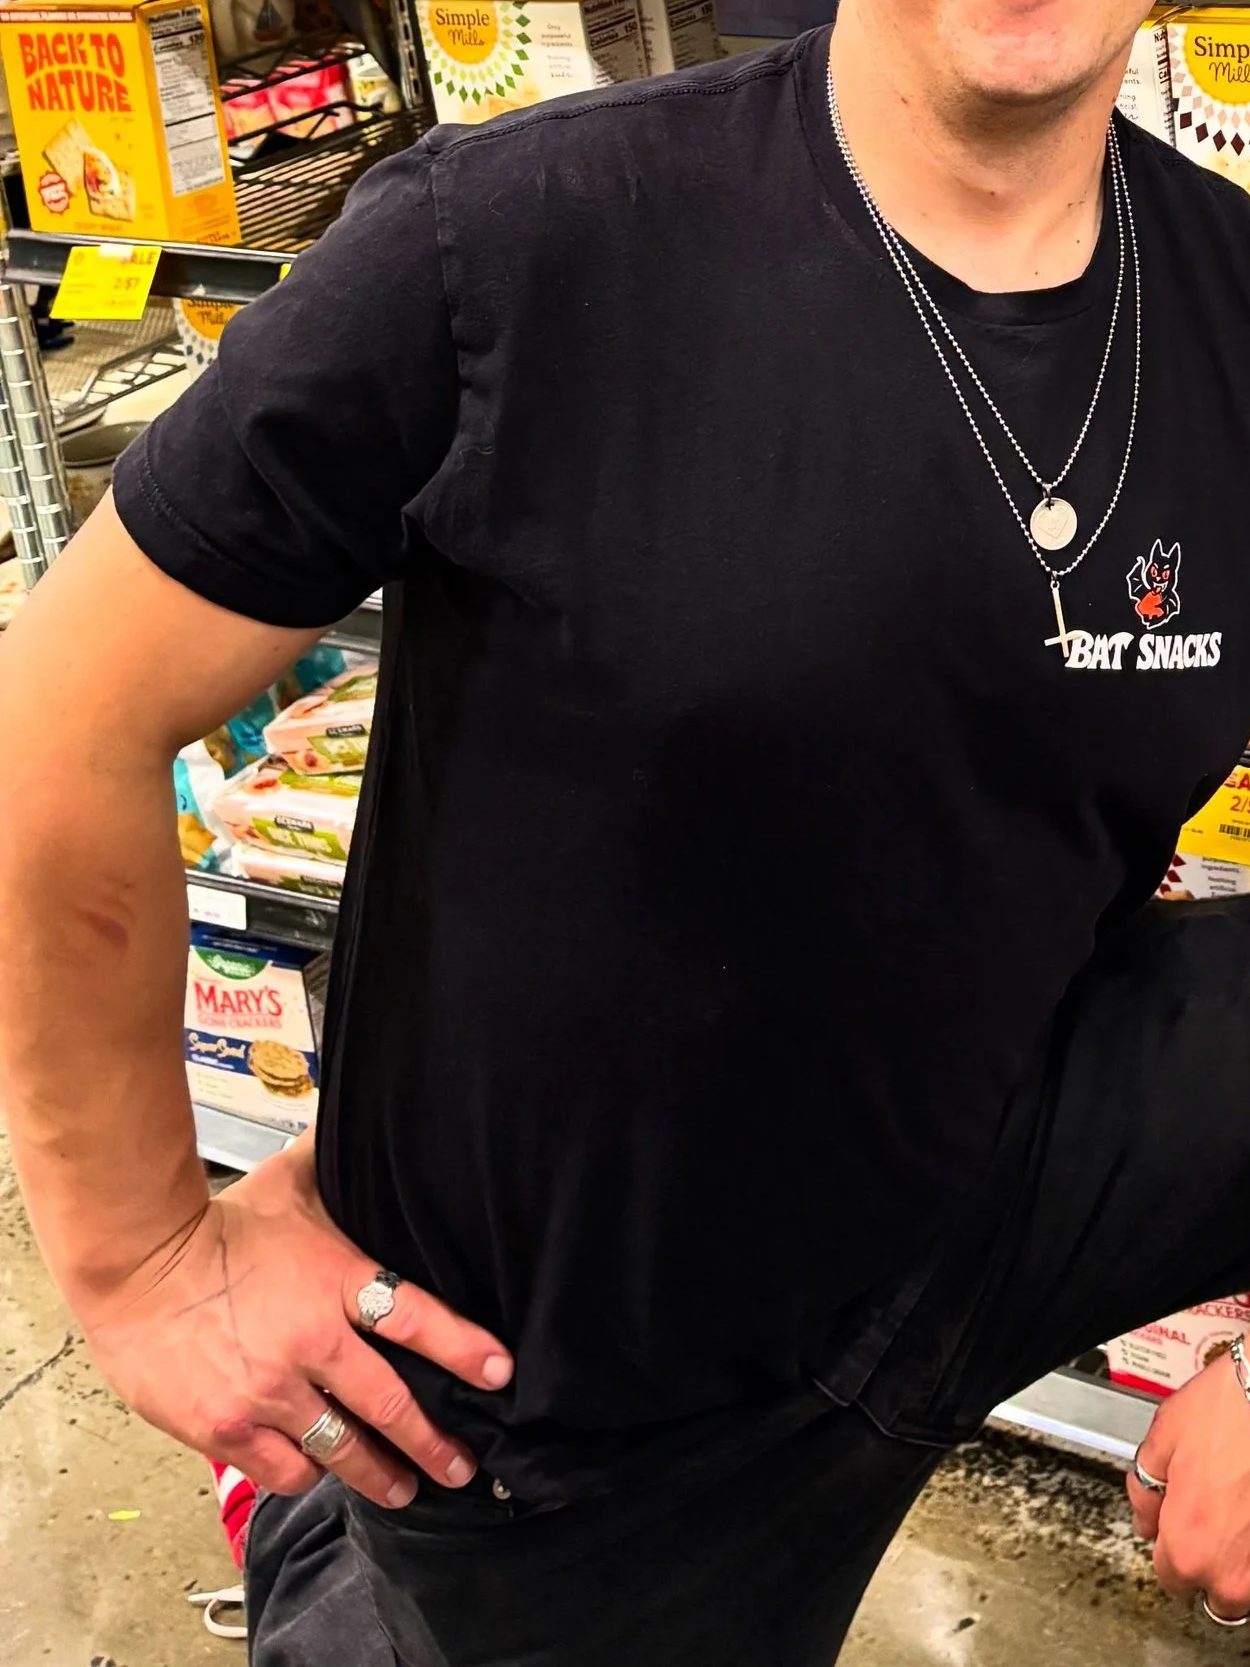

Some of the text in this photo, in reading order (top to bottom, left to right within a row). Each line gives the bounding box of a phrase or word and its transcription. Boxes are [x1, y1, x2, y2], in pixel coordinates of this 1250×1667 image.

[1065, 630, 1222, 670] BAT SNACKS
[193, 981, 282, 1017] MARY'S
